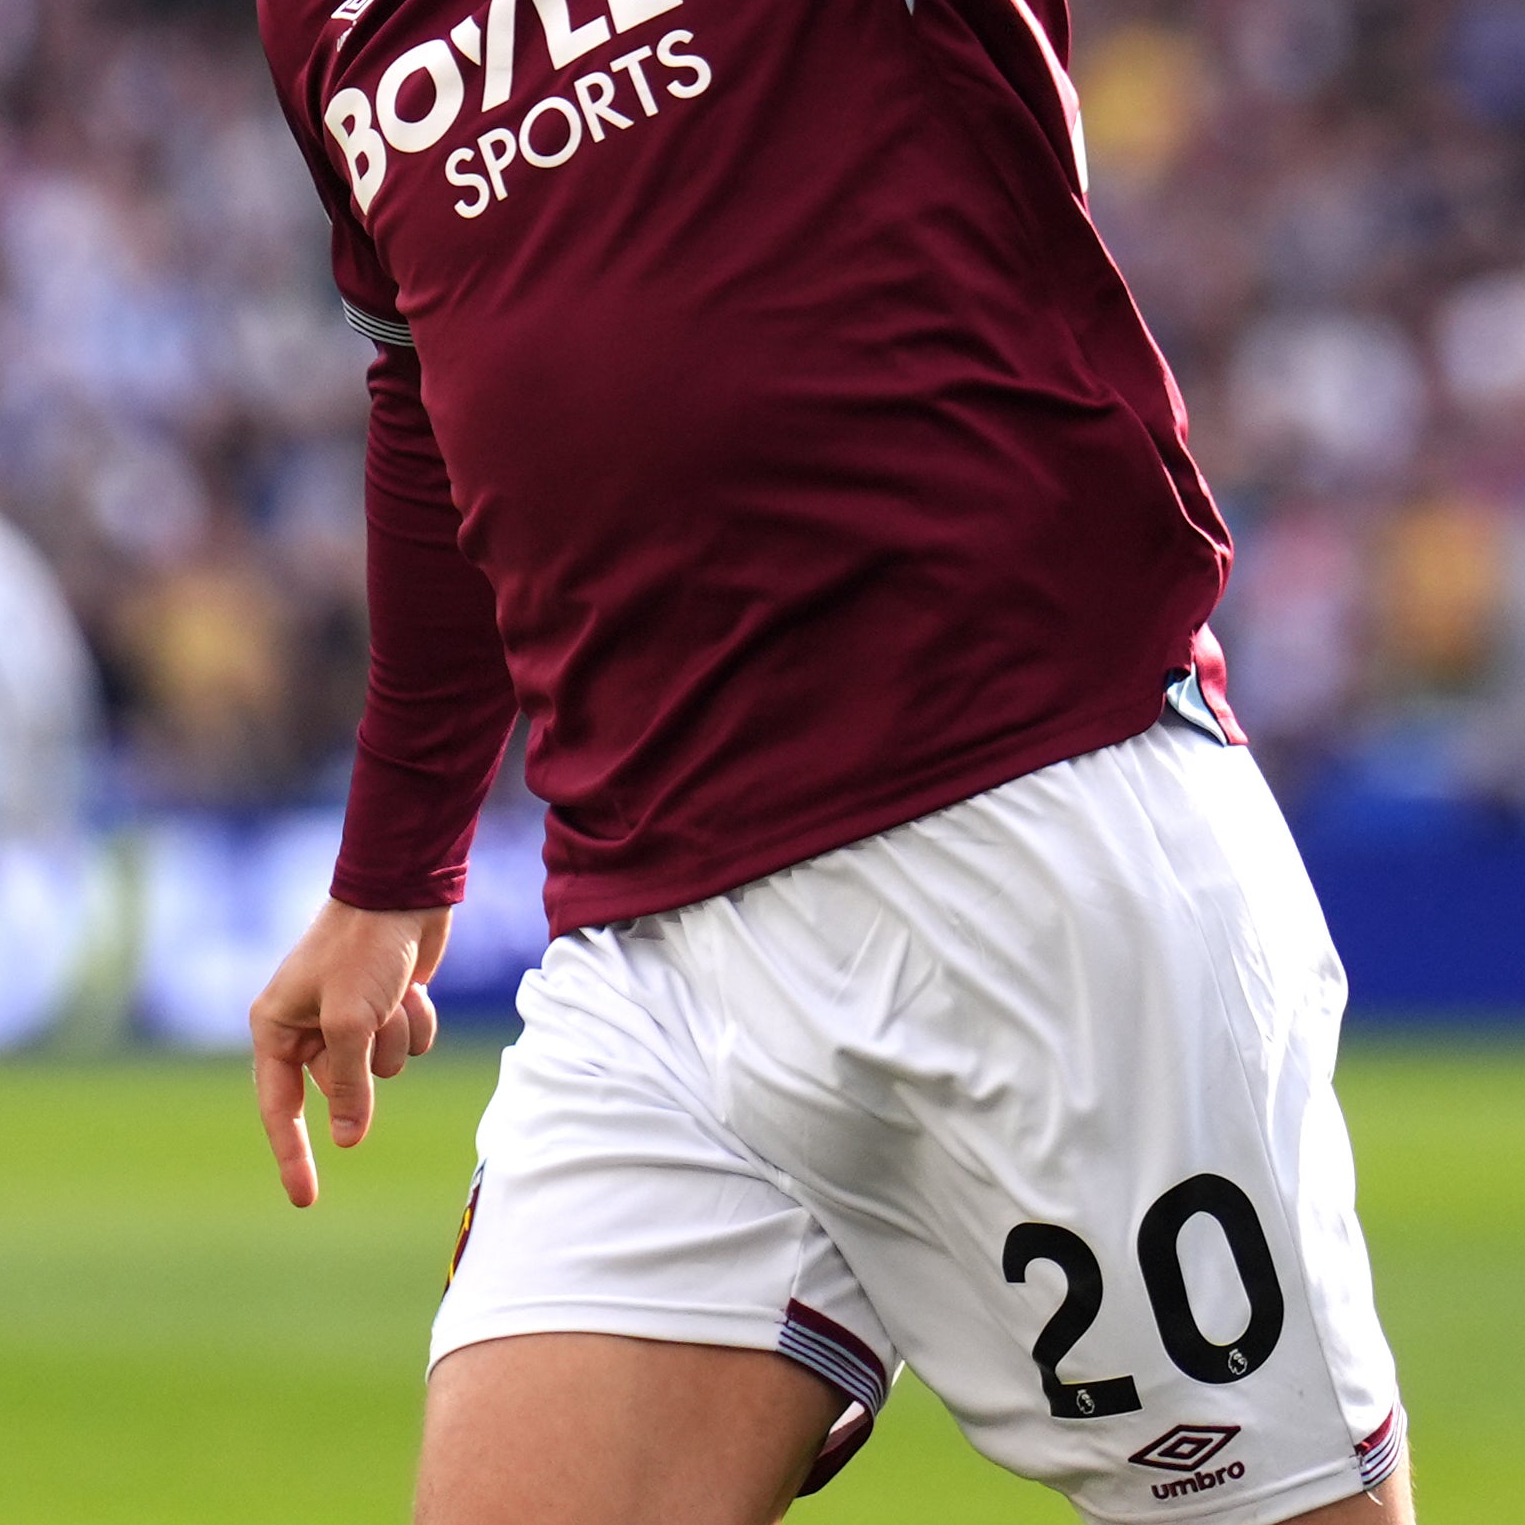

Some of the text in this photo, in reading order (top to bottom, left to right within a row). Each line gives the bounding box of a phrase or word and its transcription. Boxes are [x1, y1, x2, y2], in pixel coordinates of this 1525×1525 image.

[444, 28, 713, 219] SPORTS
[1002, 1172, 1285, 1419] 20
[1151, 1460, 1246, 1501] umbro
